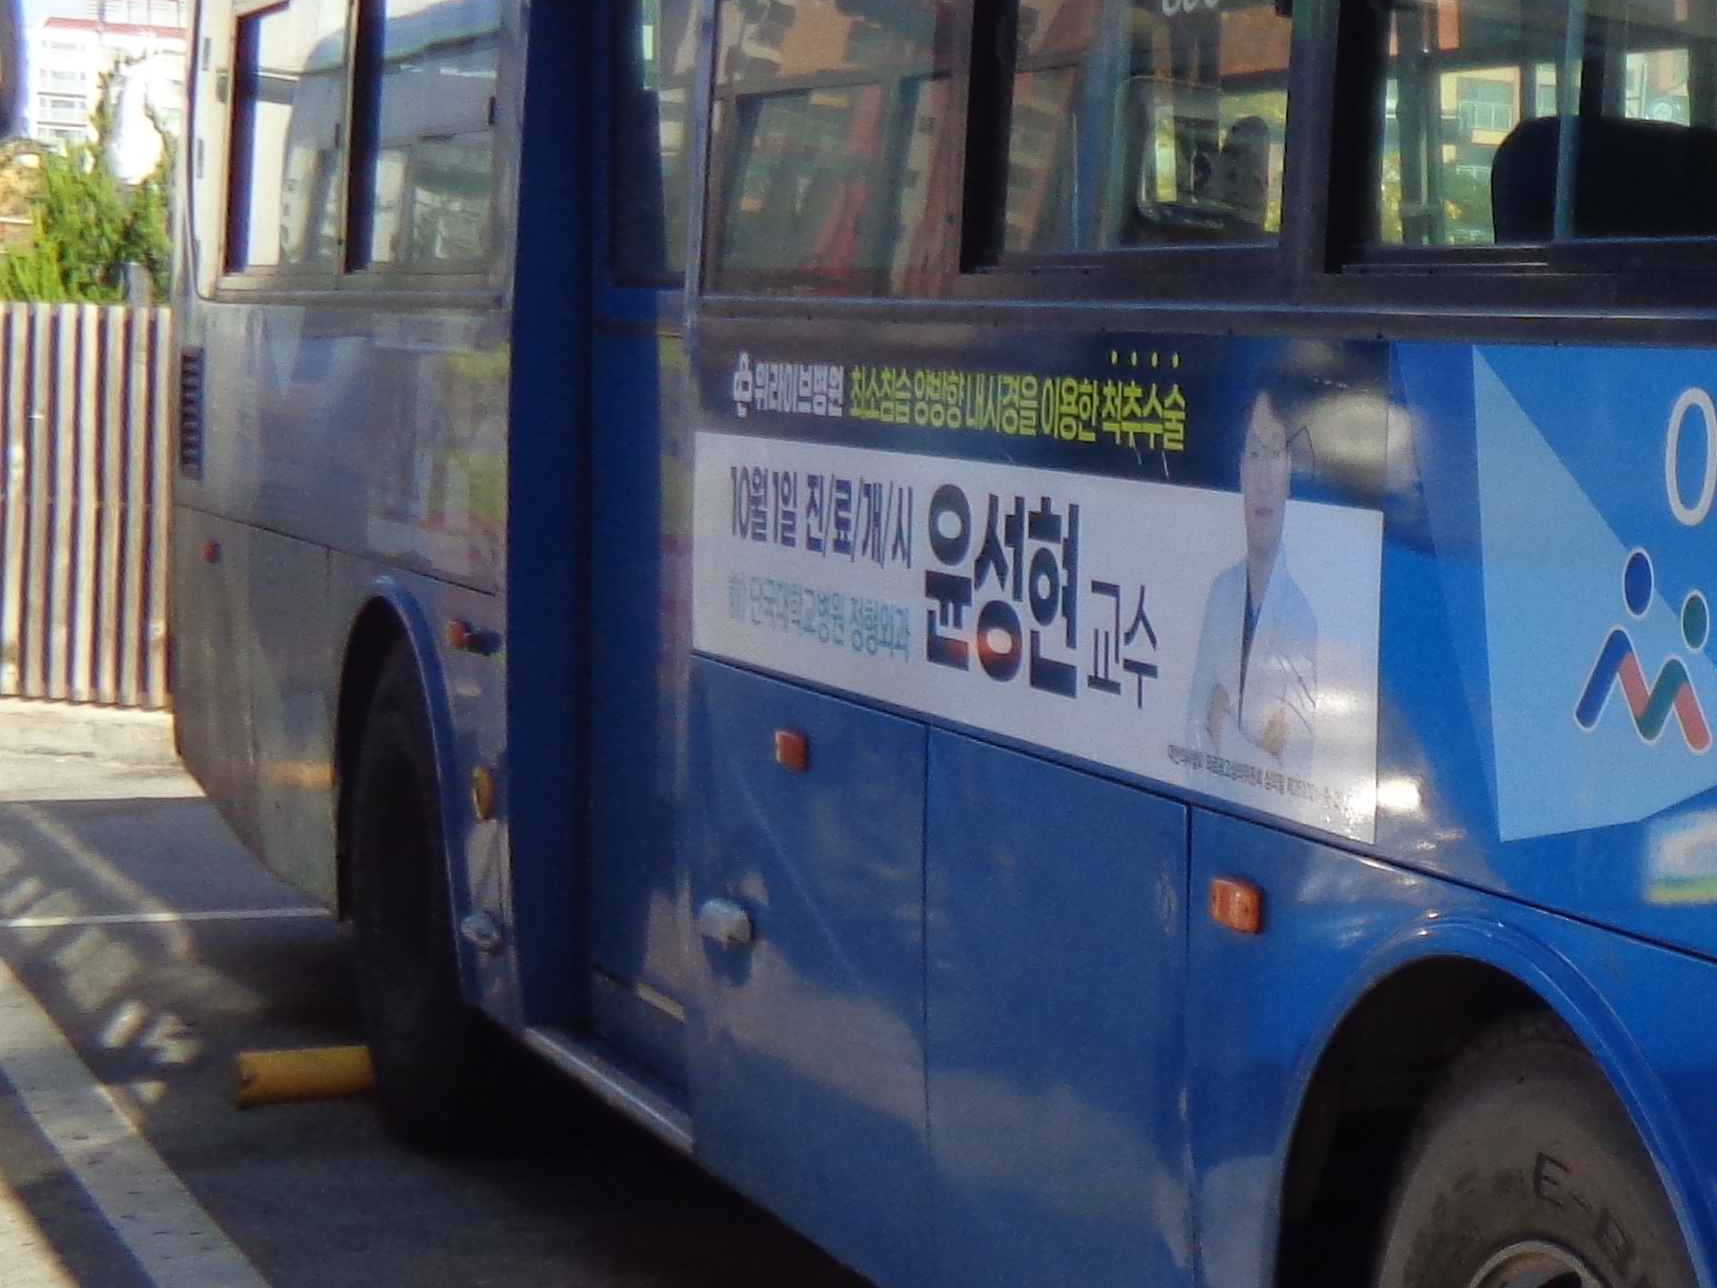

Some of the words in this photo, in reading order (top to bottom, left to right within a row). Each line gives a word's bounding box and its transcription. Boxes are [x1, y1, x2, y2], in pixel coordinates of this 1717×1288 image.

[850, 364, 911, 424] 최소침습
[966, 372, 1038, 438] 내시경을
[1041, 375, 1098, 443] 이용한
[1101, 379, 1186, 452] 척추수술
[730, 465, 768, 542] 10월
[771, 470, 797, 548] 1일
[925, 483, 1080, 699] 윤성현
[1087, 579, 1159, 710] 교수
